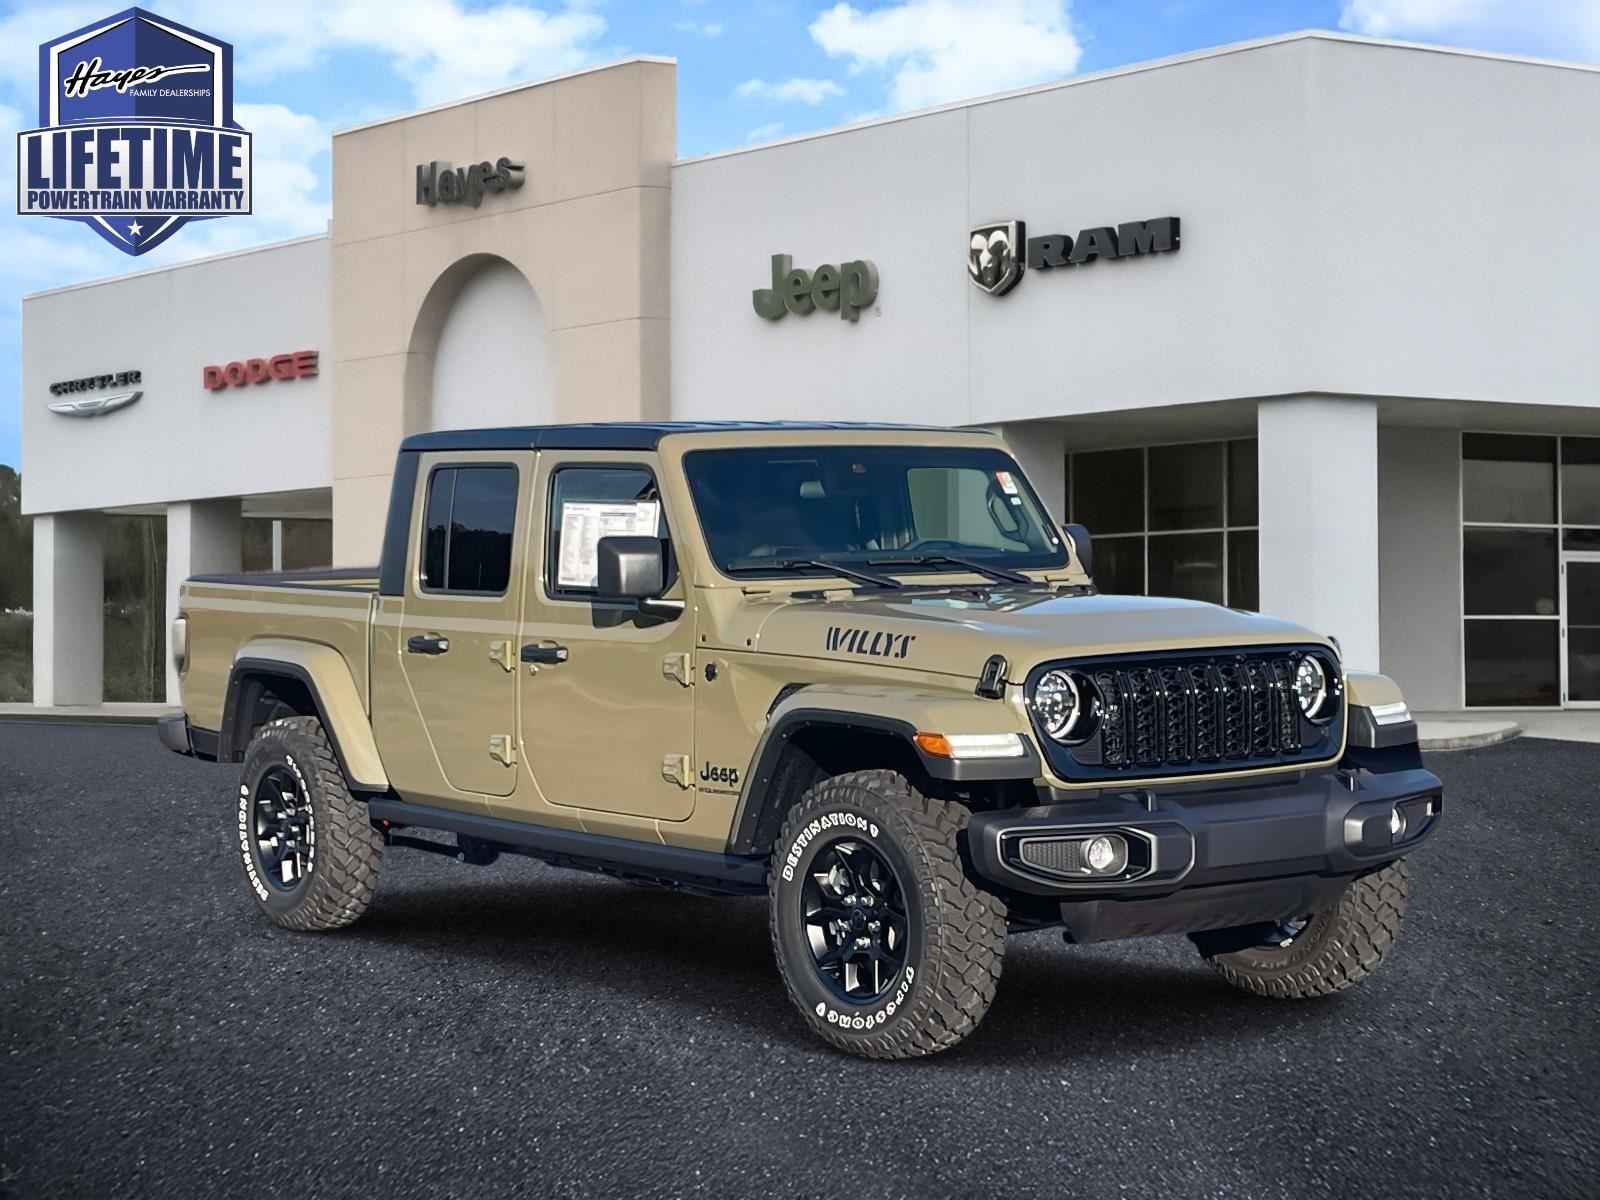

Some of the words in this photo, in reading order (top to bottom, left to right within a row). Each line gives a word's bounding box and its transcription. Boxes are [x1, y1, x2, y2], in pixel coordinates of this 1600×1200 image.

[416, 156, 526, 208] Hayes
[1028, 216, 1181, 270] RAM
[752, 253, 880, 322] Jeep
[203, 350, 320, 391] DODGE
[825, 626, 917, 659] WILLYS
[700, 760, 740, 788] Jeep
[782, 812, 868, 882] DESTINATION
